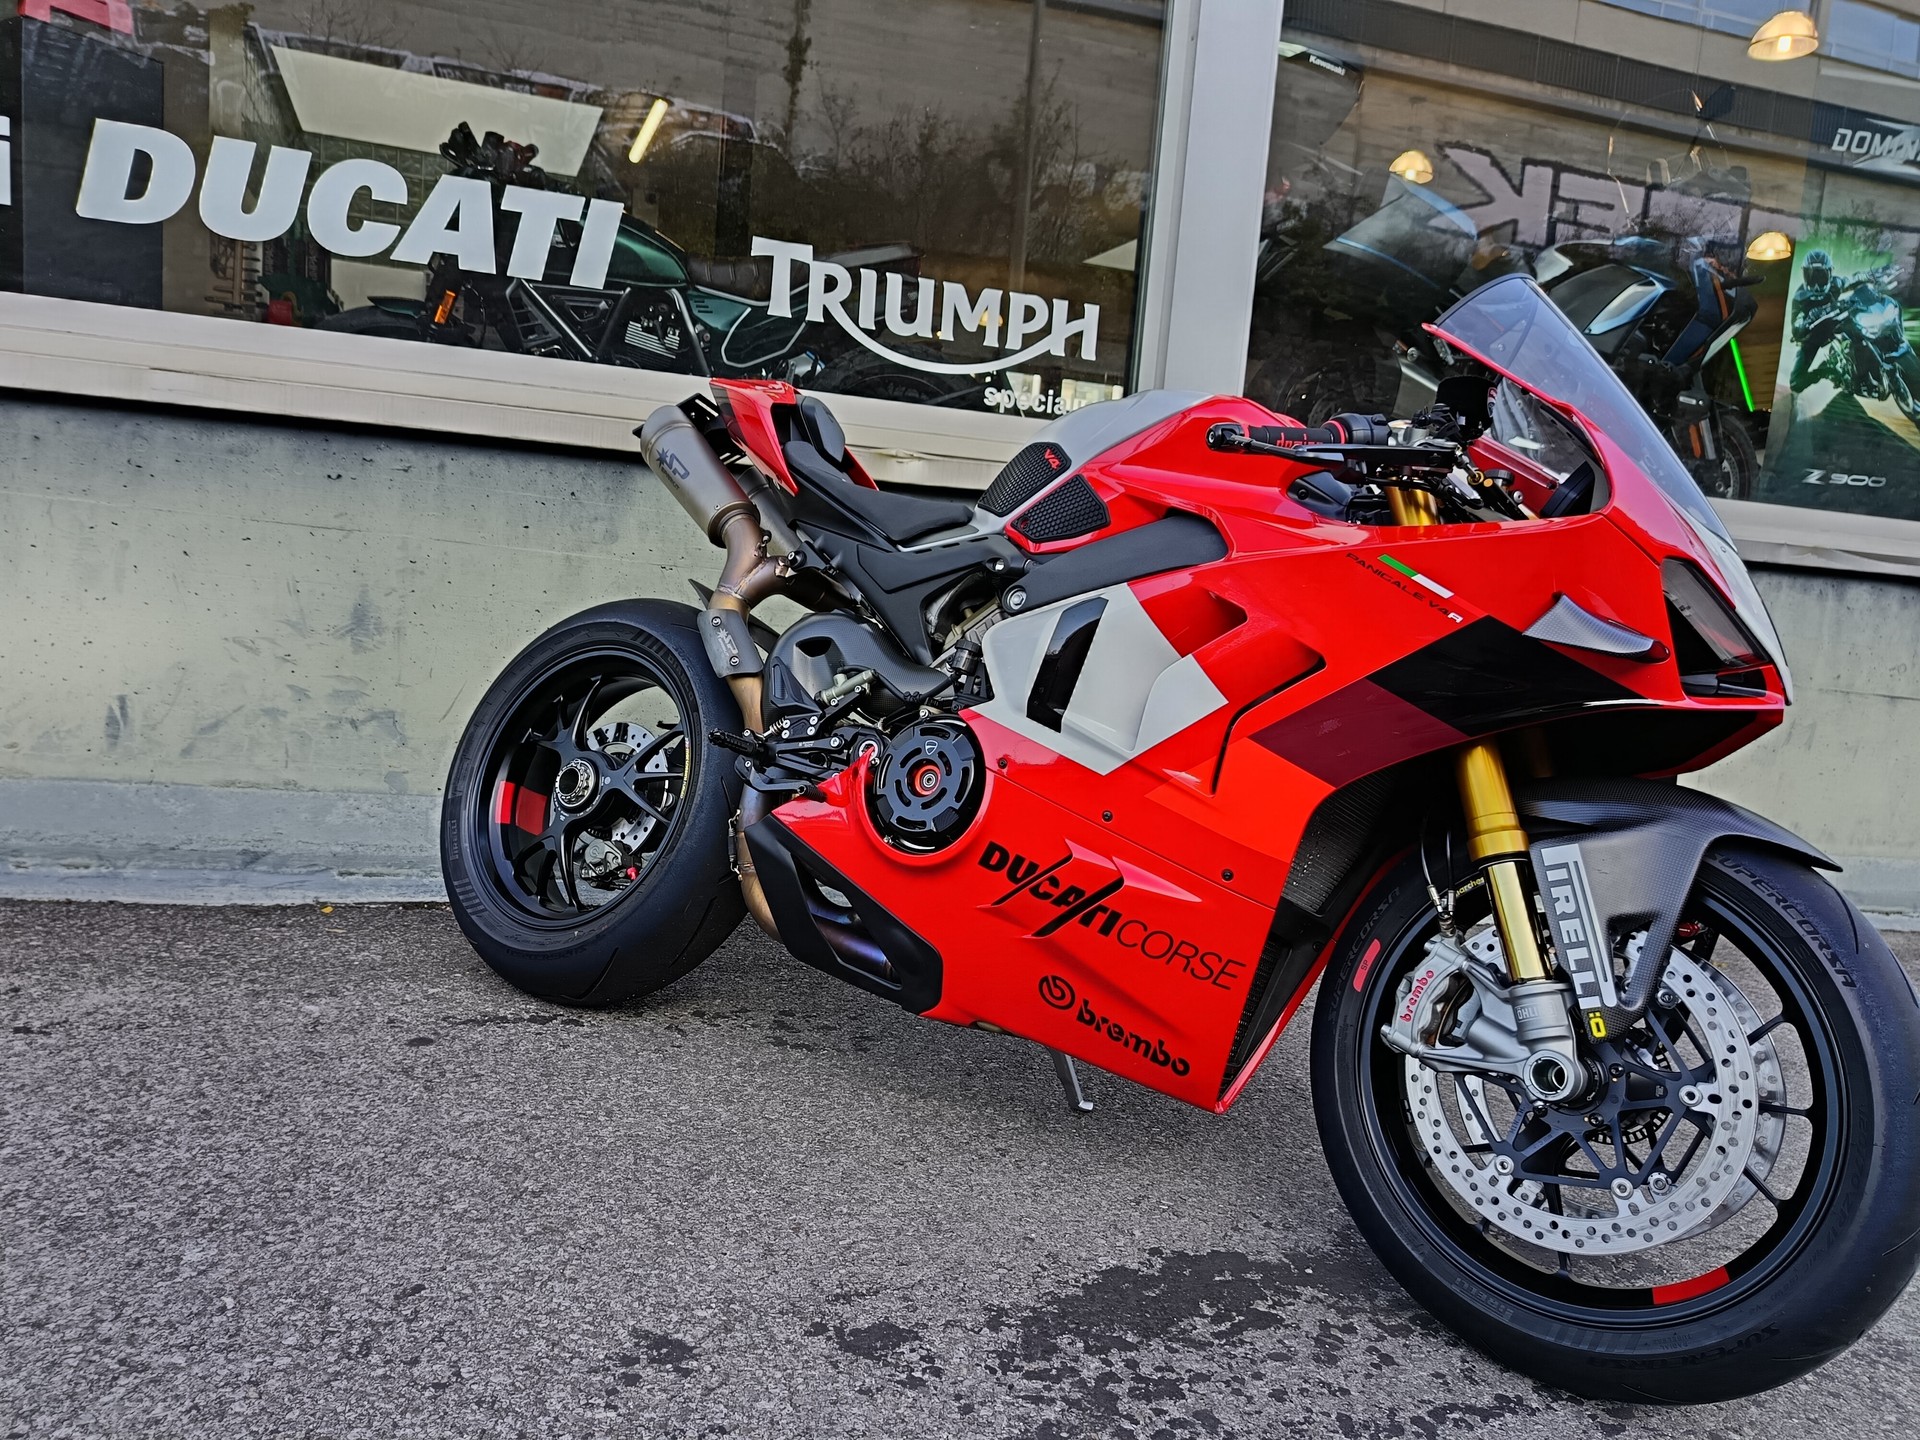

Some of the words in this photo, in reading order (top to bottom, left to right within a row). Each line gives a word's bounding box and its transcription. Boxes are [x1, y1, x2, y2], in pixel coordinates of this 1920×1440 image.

[76, 117, 624, 290] DUCATI
[750, 235, 1100, 375] TRIUMPH
[1044, 448, 1061, 470] V4
[1360, 959, 1369, 971] SP
[1541, 844, 1618, 1009] PIRELLI
[1701, 853, 1858, 989] SUPERCORSA
[1076, 998, 1190, 1077] brembo
[1400, 970, 1435, 1022] brembo
